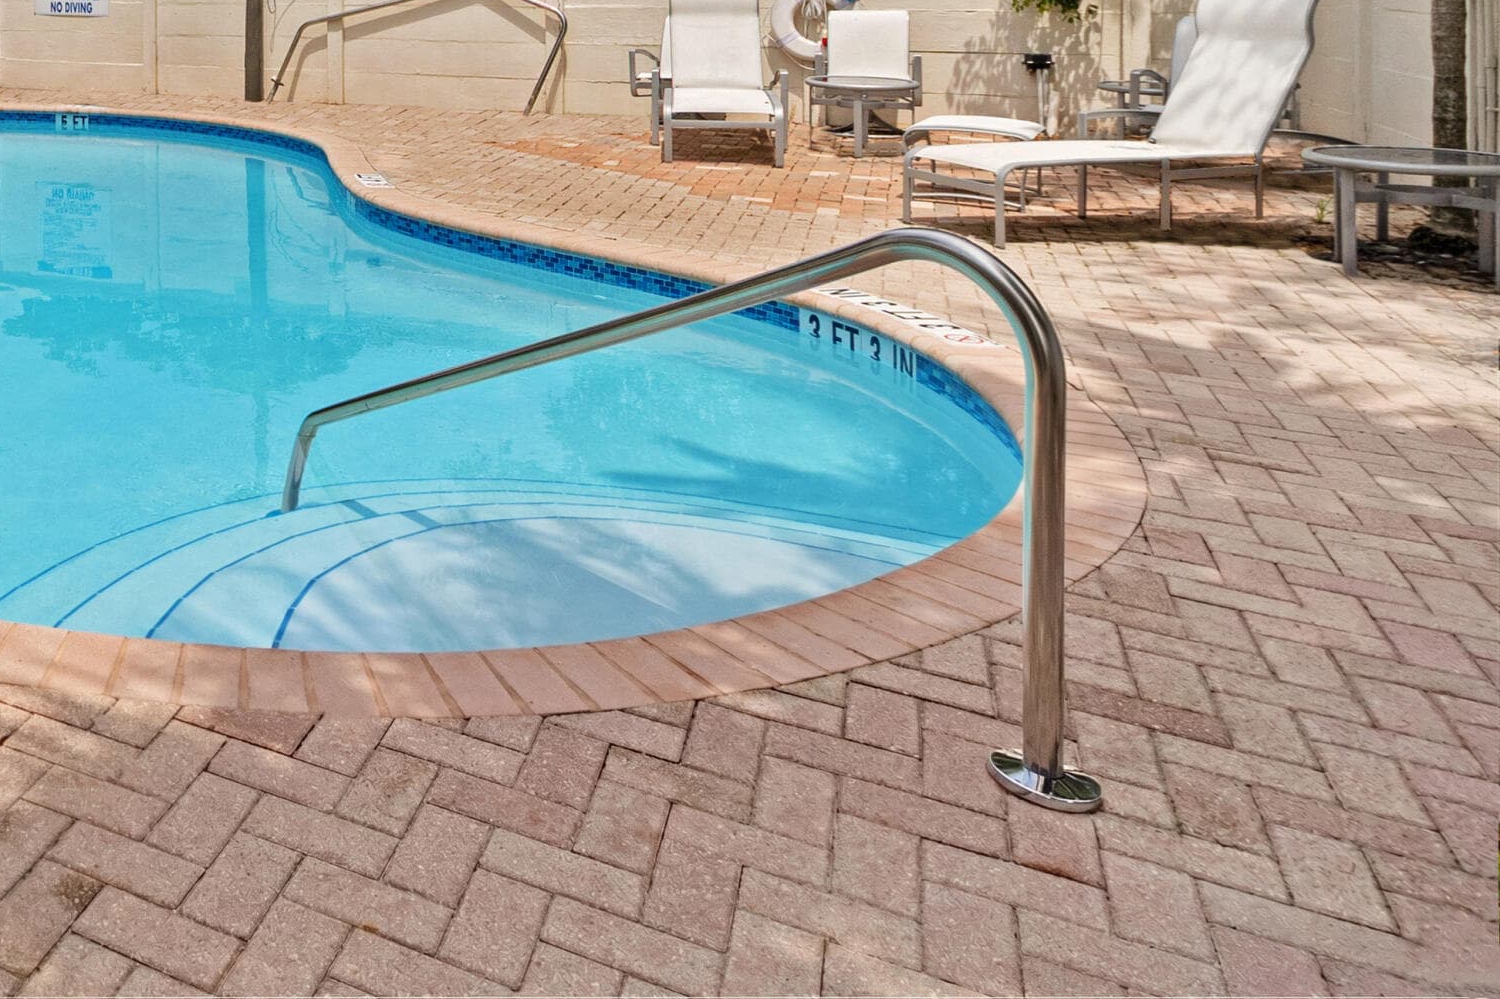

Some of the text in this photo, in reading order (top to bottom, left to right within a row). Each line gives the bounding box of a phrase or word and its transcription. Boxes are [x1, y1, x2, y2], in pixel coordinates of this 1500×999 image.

[51, 1, 93, 13] NO DIVING
[73, 115, 87, 129] FT
[808, 314, 913, 378] 3 FT 3 IN
